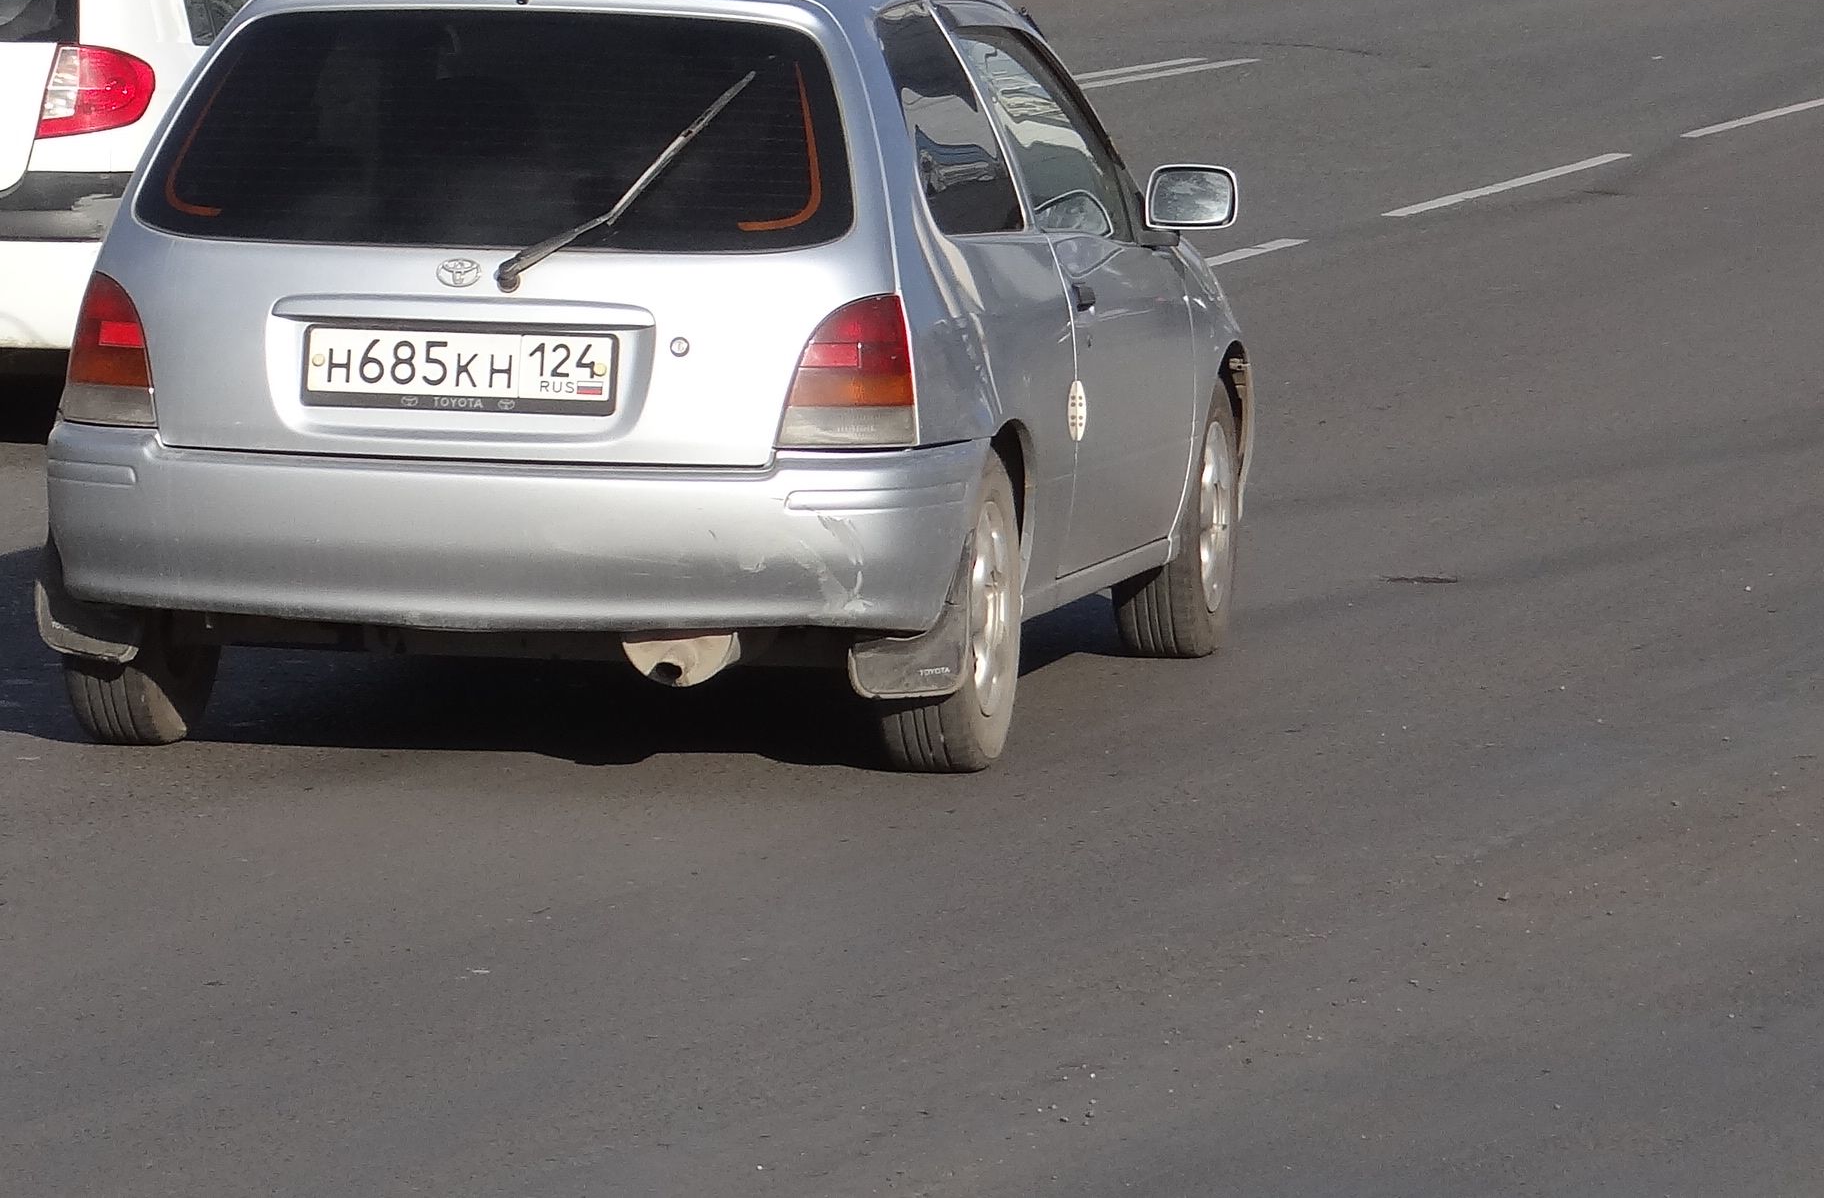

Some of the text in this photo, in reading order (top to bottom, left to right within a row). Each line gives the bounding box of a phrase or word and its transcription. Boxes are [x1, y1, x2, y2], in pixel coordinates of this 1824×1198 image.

[326, 338, 596, 389] Н685КН 124
[539, 381, 575, 394] RUS
[433, 397, 484, 409] TOYOTA
[919, 667, 951, 676] TOYOTA
